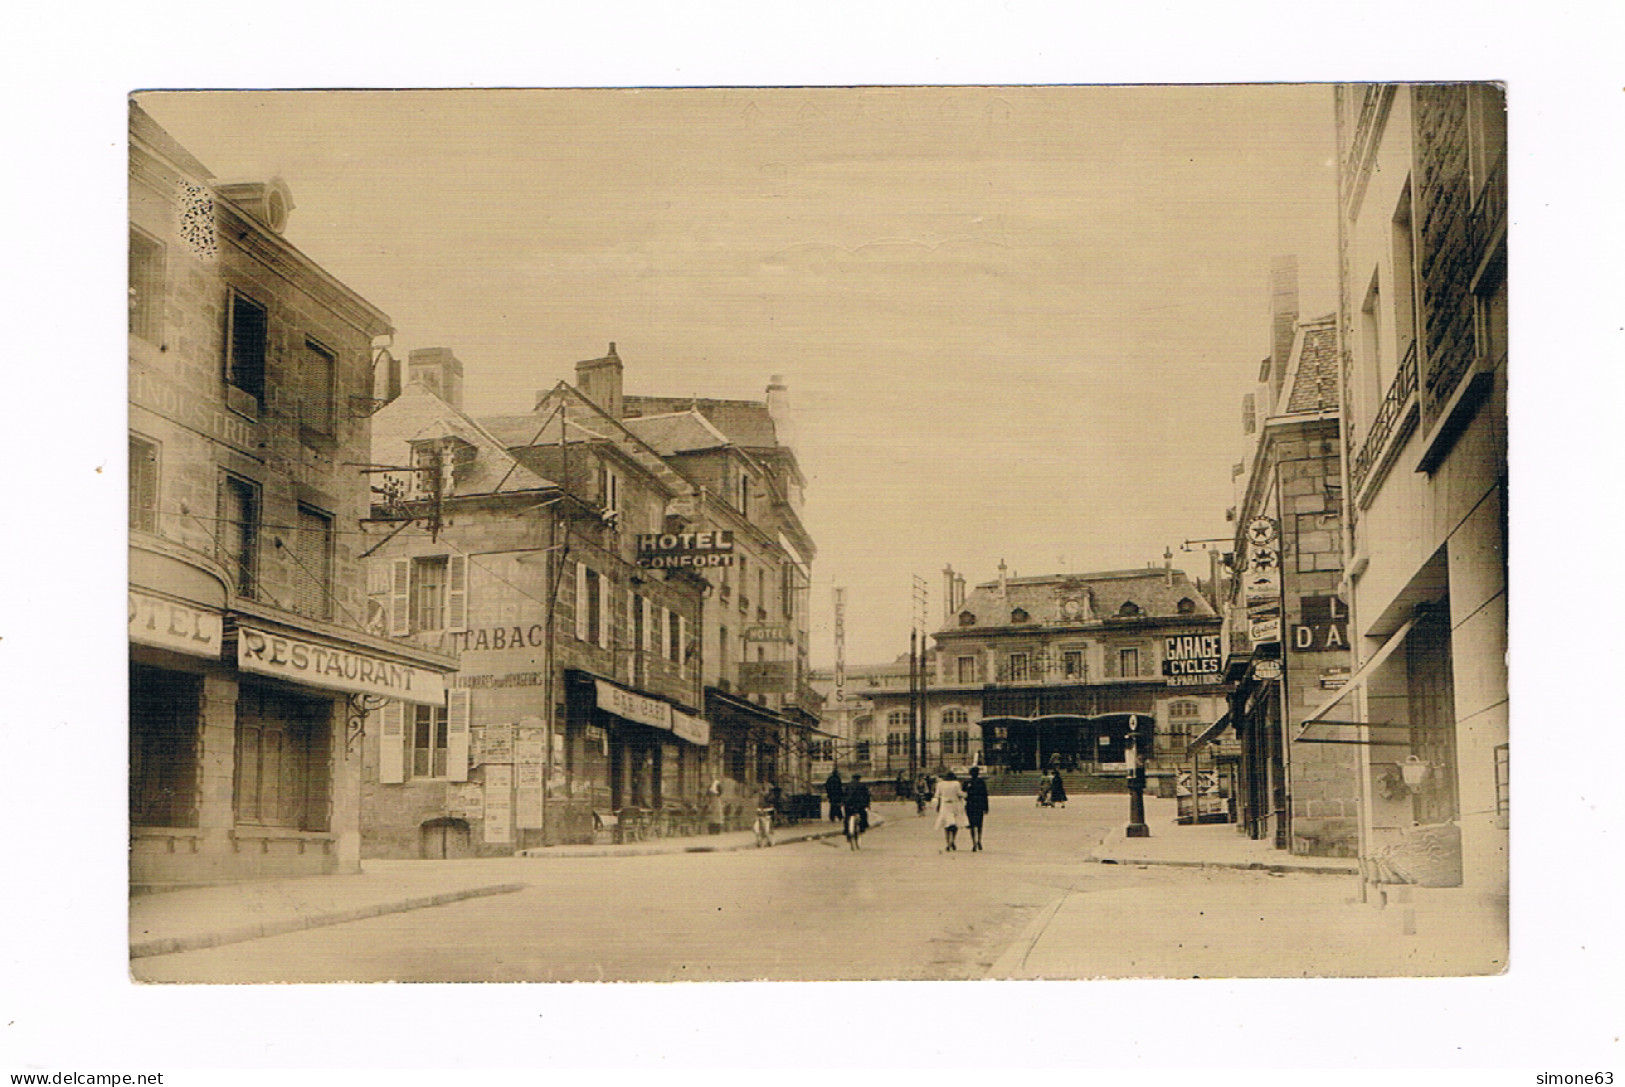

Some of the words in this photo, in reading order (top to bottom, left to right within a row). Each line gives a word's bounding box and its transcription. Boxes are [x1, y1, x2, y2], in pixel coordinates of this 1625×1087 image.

[640, 530, 732, 552] HOTEL
[638, 553, 735, 569] CONFORT
[458, 623, 542, 651] TABAC
[835, 587, 845, 703] TERMINUS
[1166, 635, 1221, 660] GARAGE
[243, 626, 415, 690] RESTAURANT
[1171, 659, 1218, 674] CYCLES
